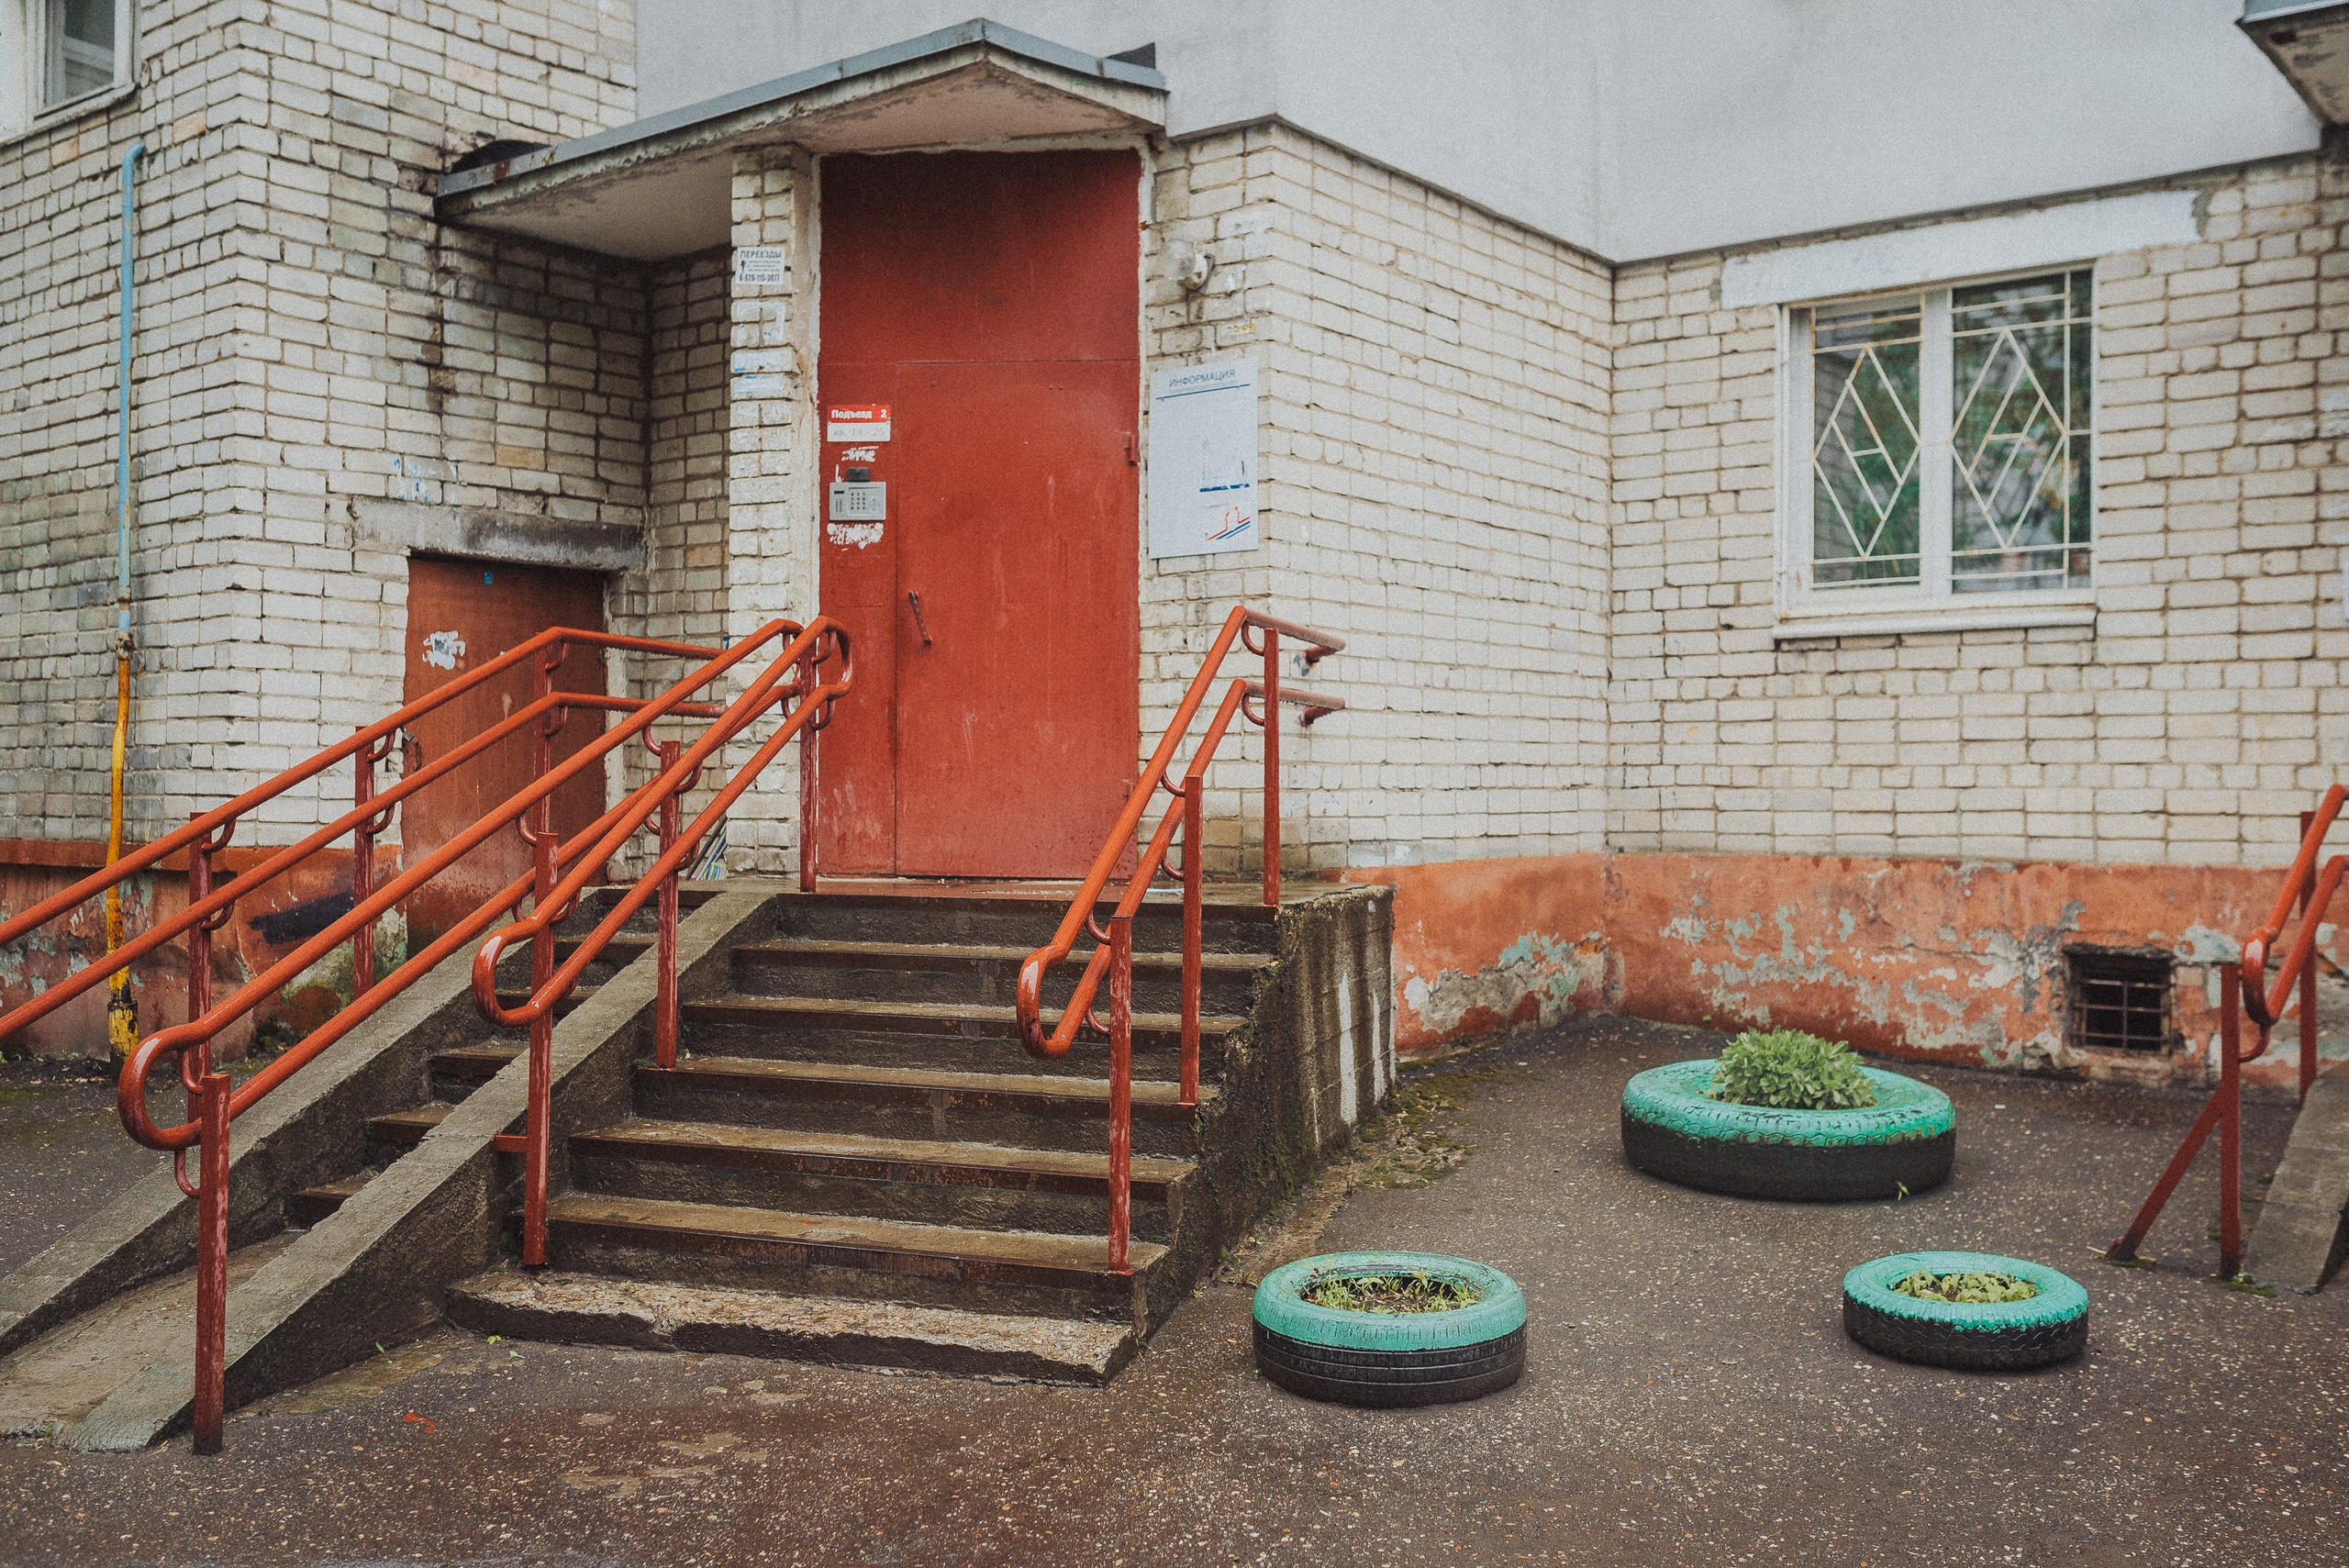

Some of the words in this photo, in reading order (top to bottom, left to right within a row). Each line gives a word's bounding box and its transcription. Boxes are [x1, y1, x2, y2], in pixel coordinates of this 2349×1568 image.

[740, 250, 782, 259] ПЕРЕЕЗДЫ
[1169, 369, 1236, 386] ИНФОРМАЦИЯ
[831, 410, 873, 419] Подъезд
[881, 409, 887, 418] 2
